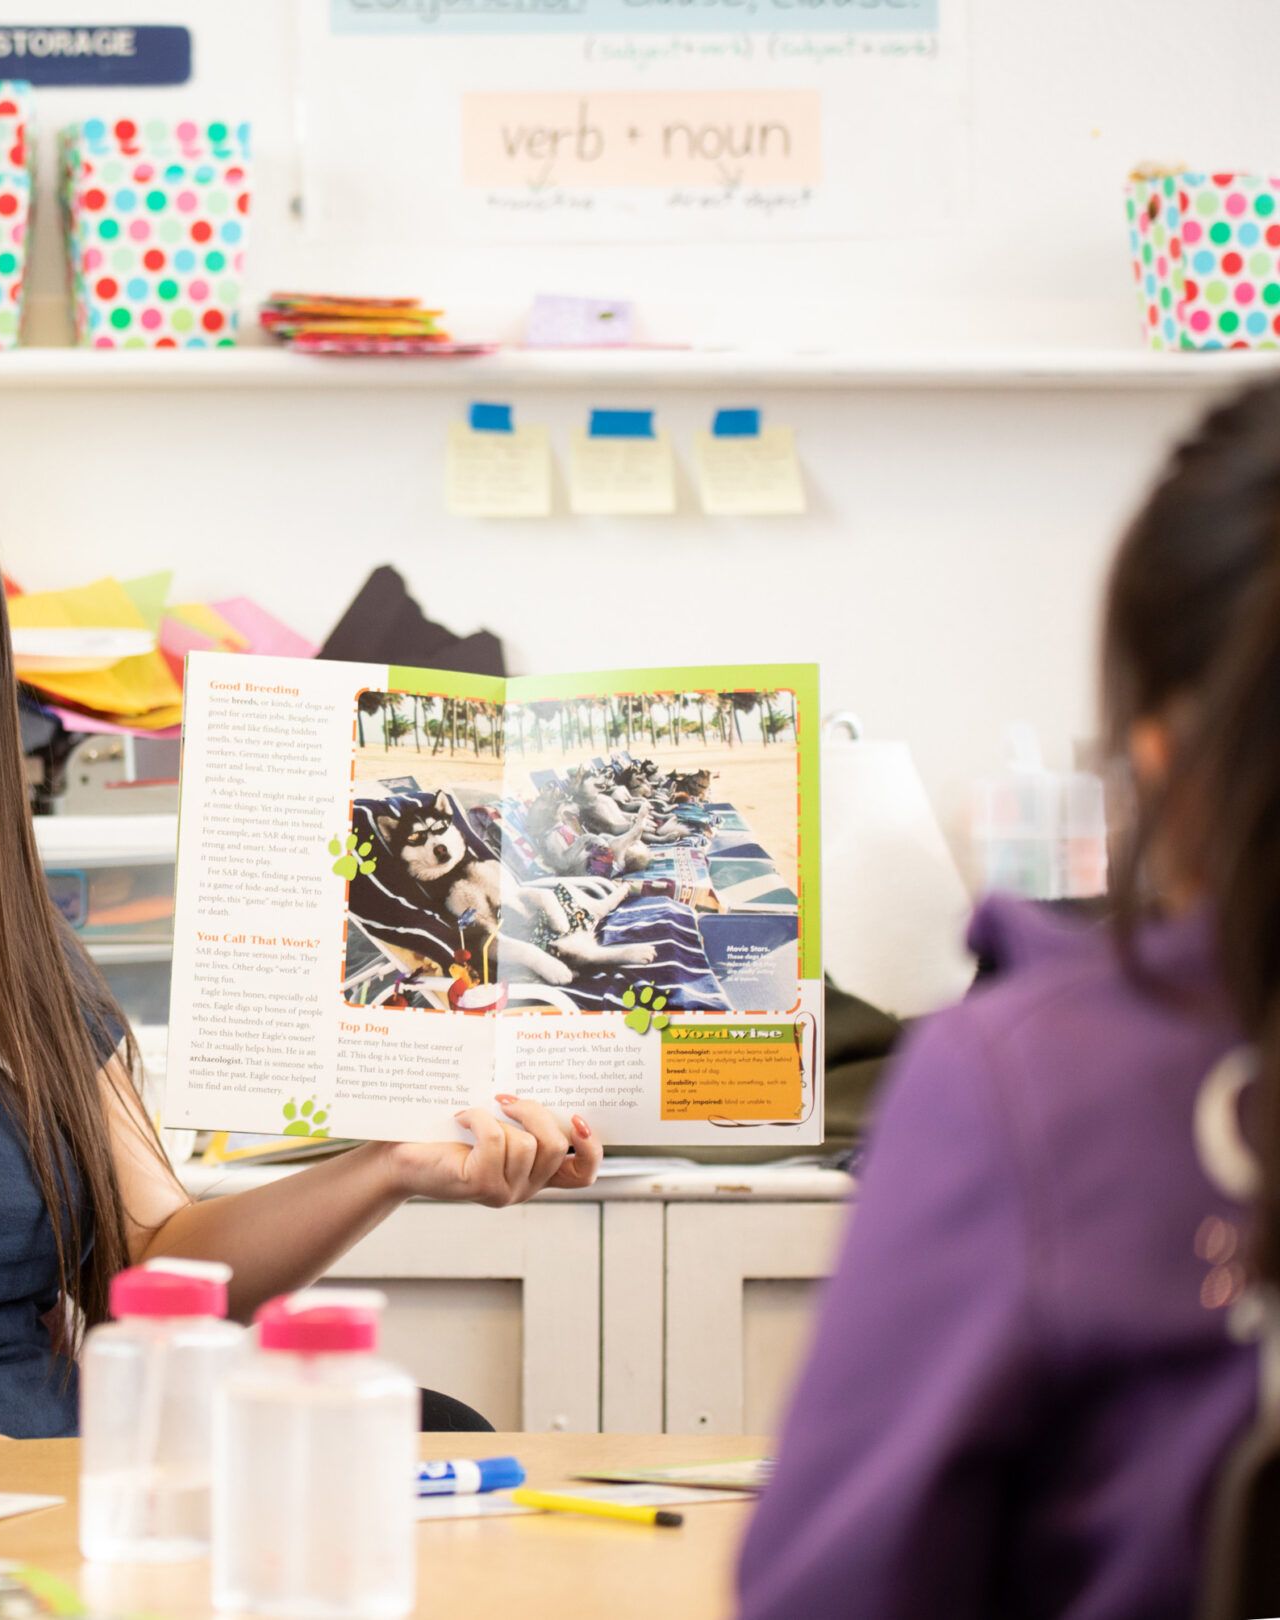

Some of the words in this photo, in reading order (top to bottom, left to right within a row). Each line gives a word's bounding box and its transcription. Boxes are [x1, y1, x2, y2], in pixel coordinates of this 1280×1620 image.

[501, 97, 605, 161] verb
[661, 119, 792, 161] noun
[209, 681, 241, 691] Good
[245, 683, 299, 697] Breeding
[198, 933, 219, 942] You
[223, 934, 246, 944] Call
[251, 936, 277, 946] That
[282, 938, 321, 949] Work?
[340, 1023, 360, 1034] Top
[364, 1024, 389, 1036] Dog
[517, 1031, 551, 1040] Pooch
[555, 1030, 617, 1041] Paychecks
[516, 1046, 535, 1055] Dogs
[537, 1045, 546, 1053] do
[548, 1045, 566, 1055] great
[569, 1045, 589, 1053] work.
[591, 1045, 612, 1053] What
[613, 1045, 624, 1053] do
[625, 1045, 642, 1054] they
[190, 1055, 243, 1066] archaeologist.
[515, 1059, 526, 1068] get
[567, 1059, 585, 1068] They
[599, 1058, 612, 1066] not
[614, 1058, 625, 1068] get
[627, 1058, 646, 1066] cash.
[560, 1073, 577, 1081] love,
[579, 1072, 599, 1081] food,
[600, 1072, 627, 1081] shelter,
[629, 1072, 643, 1080] and
[515, 1086, 534, 1096] good
[554, 1086, 574, 1096] Dogs
[575, 1086, 604, 1096] depend
[557, 1099, 585, 1109] depend
[598, 1099, 617, 1107] their
[619, 1099, 637, 1109] dogs.
